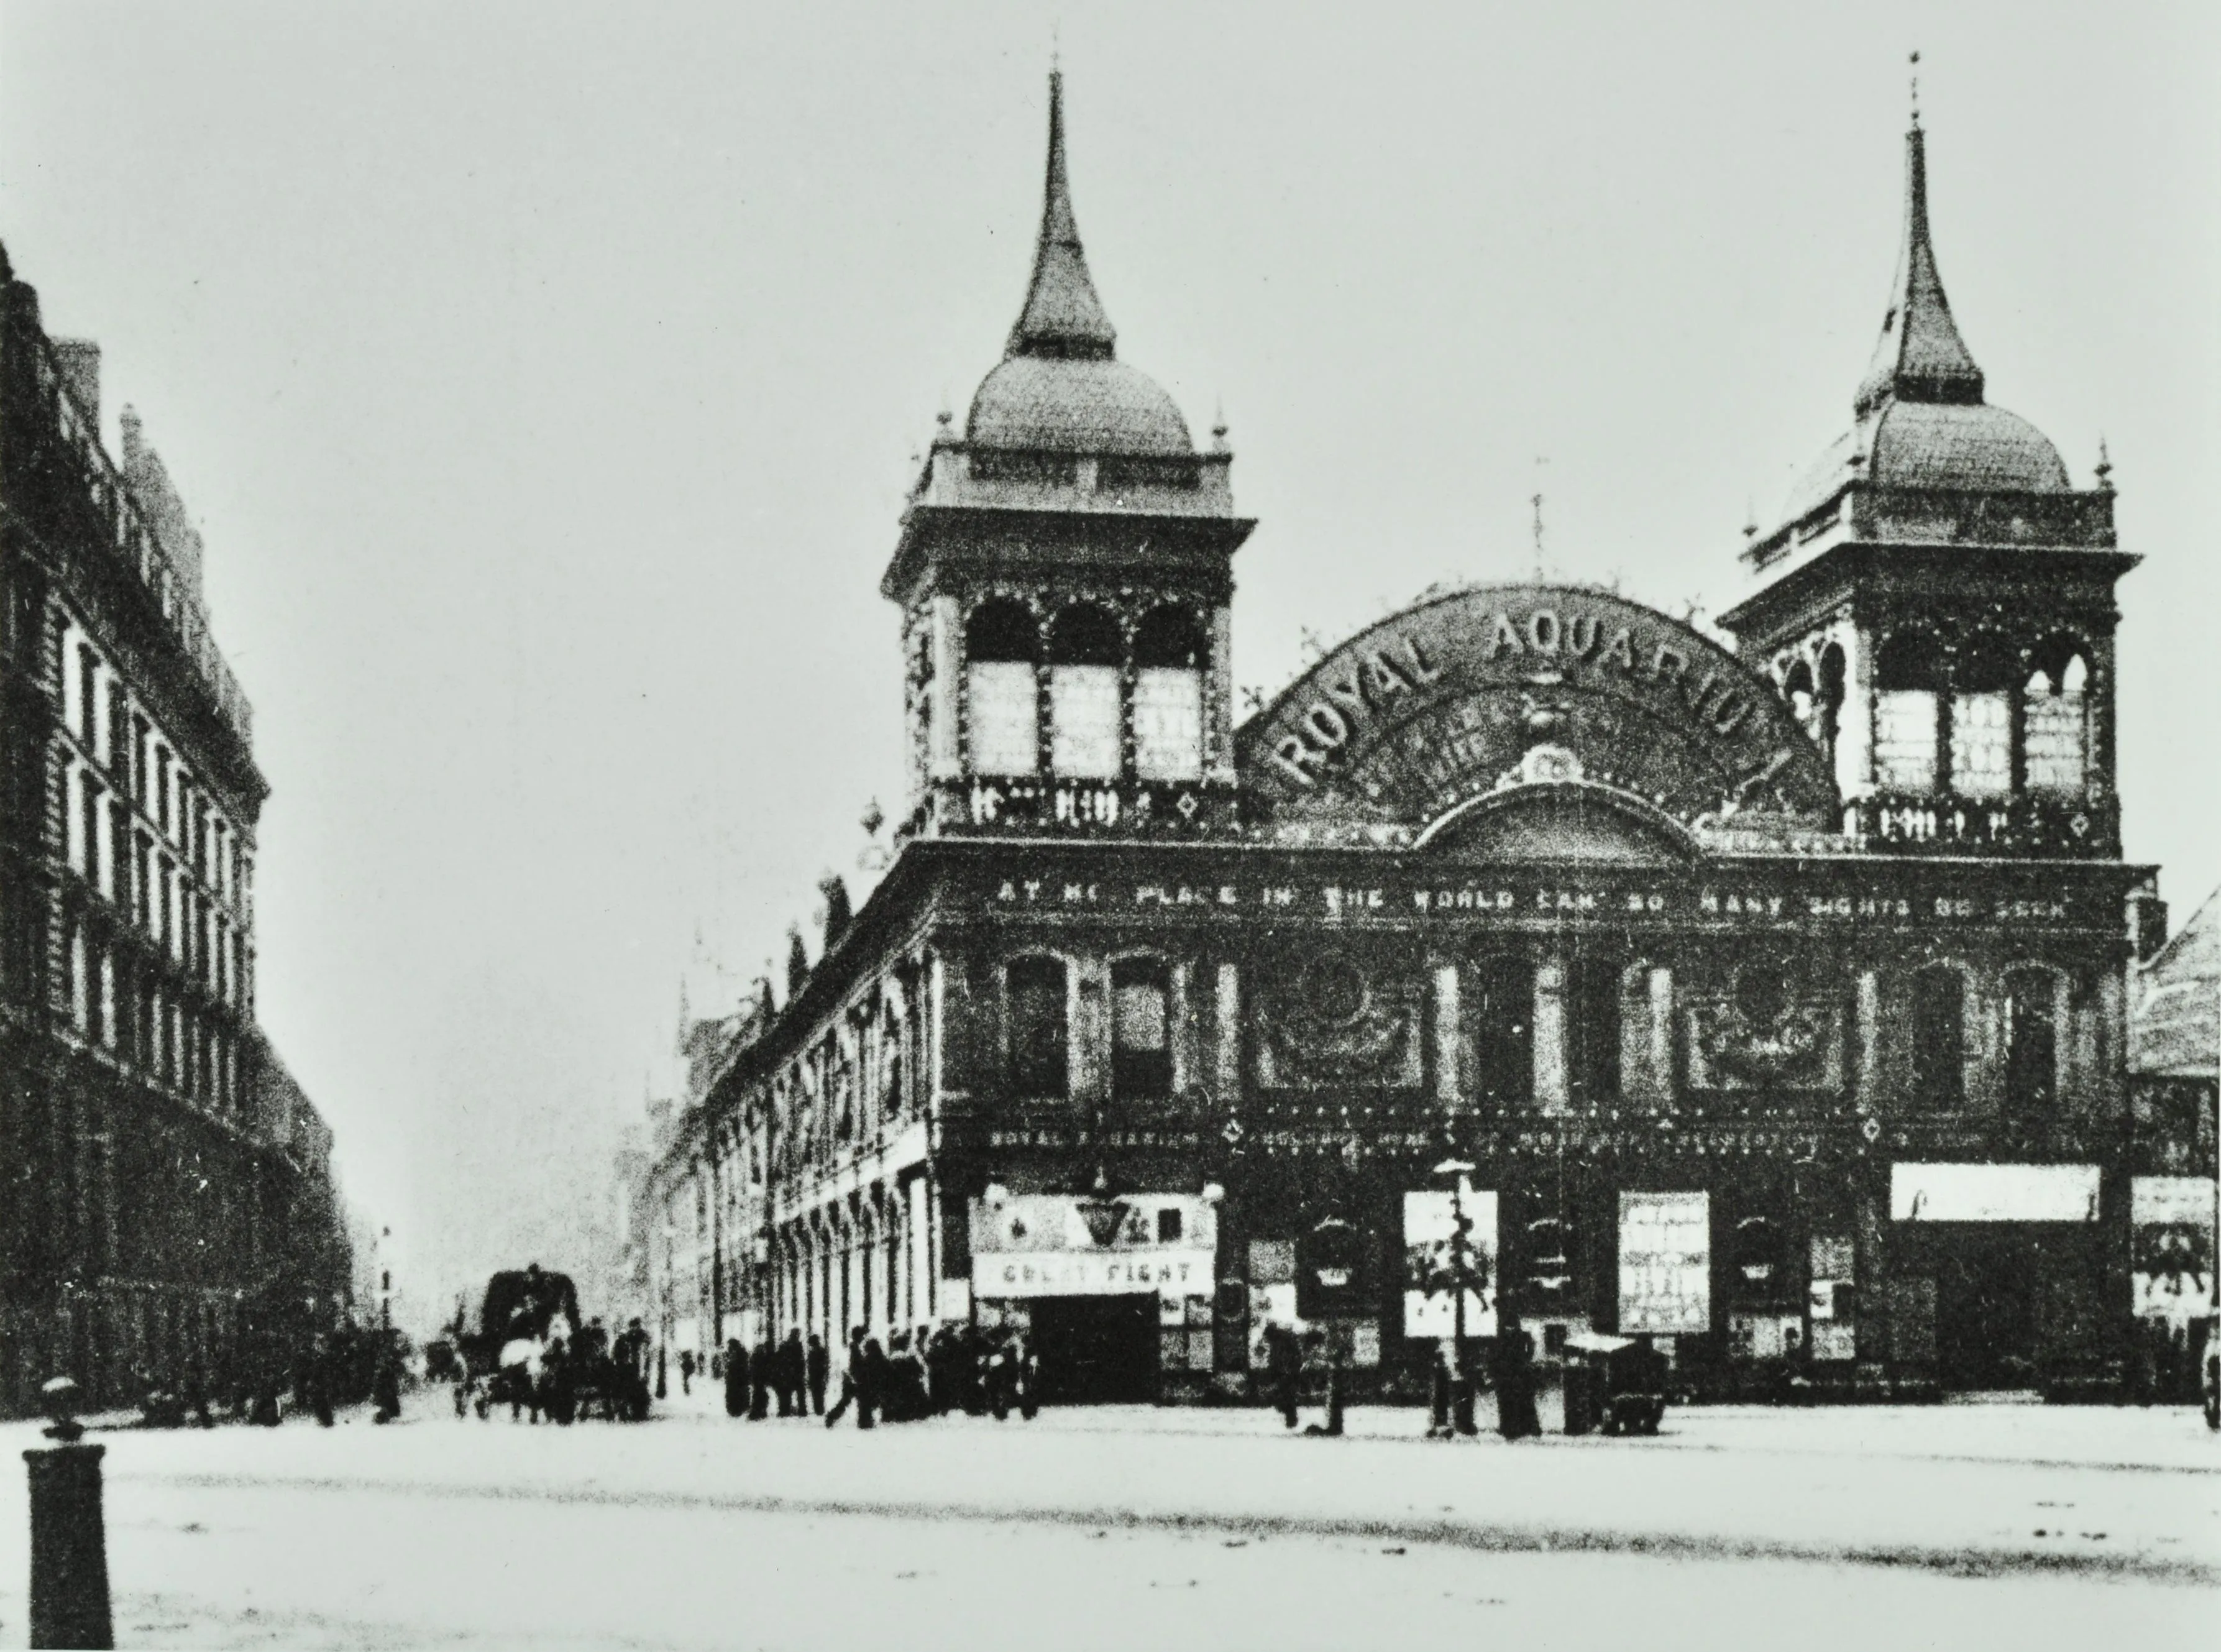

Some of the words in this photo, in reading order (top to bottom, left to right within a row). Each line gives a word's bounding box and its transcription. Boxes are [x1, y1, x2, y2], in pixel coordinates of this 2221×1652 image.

[1272, 635, 1440, 786] ROYAL
[996, 879, 1040, 901] AT
[1136, 884, 1237, 906] PLACE
[1322, 887, 1384, 907] THE
[1414, 890, 1514, 909] WORLD
[1701, 894, 1783, 914] MANY
